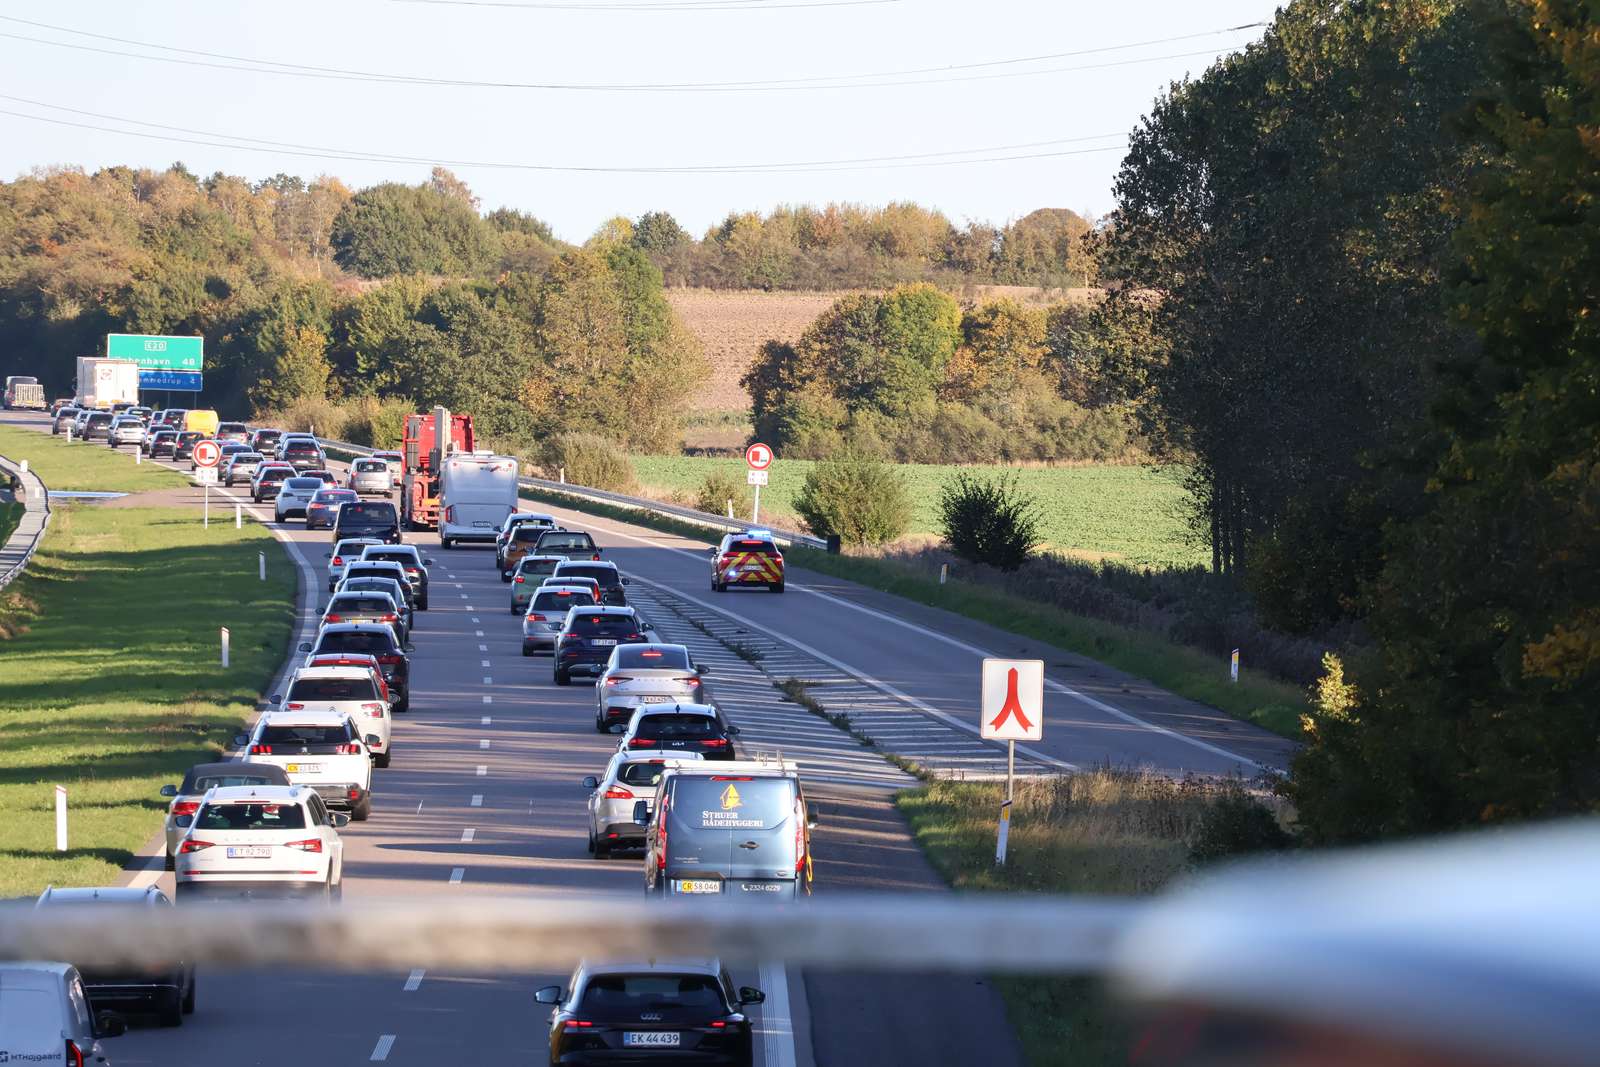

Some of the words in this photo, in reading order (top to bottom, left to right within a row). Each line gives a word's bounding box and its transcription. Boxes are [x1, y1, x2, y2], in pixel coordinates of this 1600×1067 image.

[631, 1034, 644, 1043] EK
[646, 1034, 659, 1043] 44
[660, 1034, 679, 1043] 439
